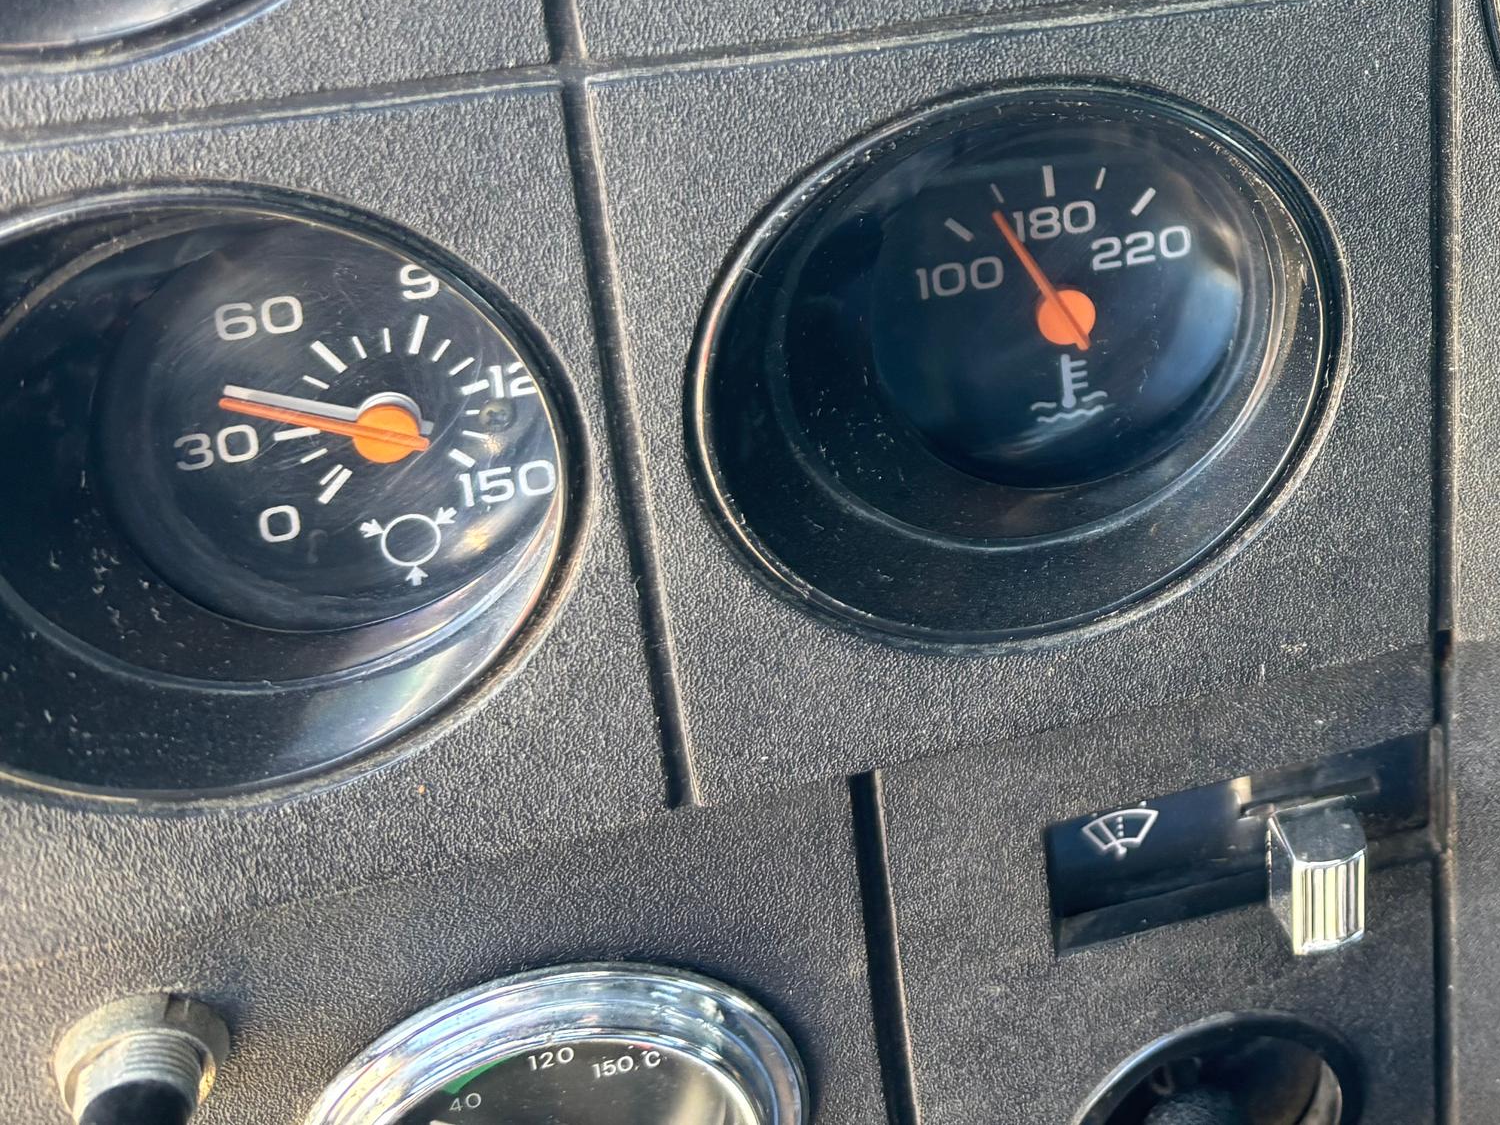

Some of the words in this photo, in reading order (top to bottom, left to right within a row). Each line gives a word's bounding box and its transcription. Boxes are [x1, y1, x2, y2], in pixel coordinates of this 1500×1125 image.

[1012, 200, 1096, 243] 180
[1091, 226, 1191, 271] 220
[916, 256, 1004, 300] 100
[214, 296, 303, 341] 60
[174, 425, 259, 471] 30
[458, 459, 556, 507] 150
[259, 505, 301, 543] 0
[527, 1046, 575, 1071] 120
[449, 1092, 482, 1114] 40
